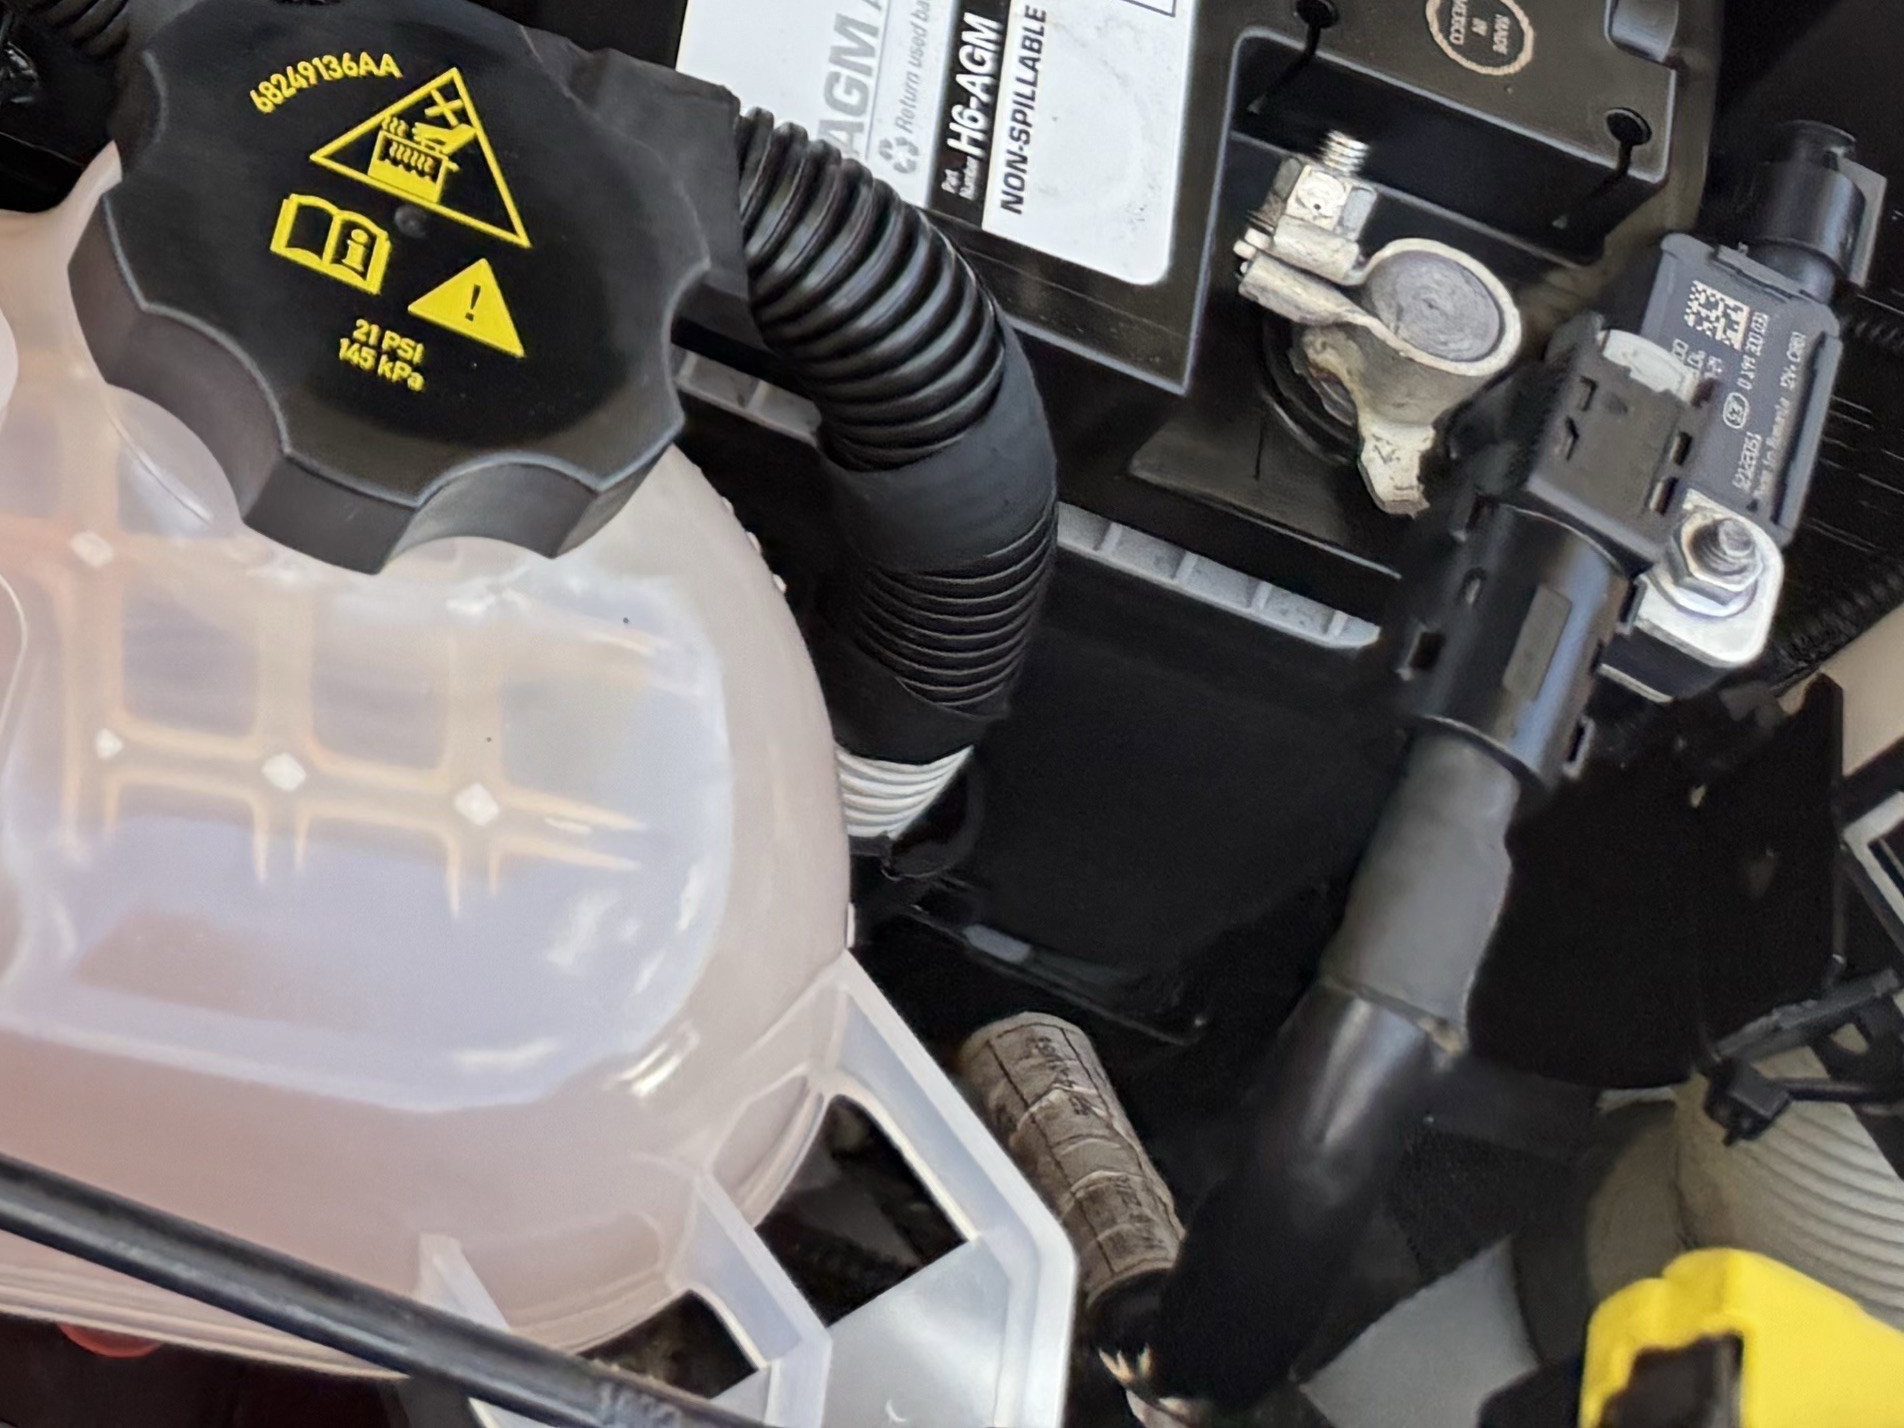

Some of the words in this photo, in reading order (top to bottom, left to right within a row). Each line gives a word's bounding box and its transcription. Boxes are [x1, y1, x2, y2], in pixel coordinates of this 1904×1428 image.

[249, 52, 404, 115] 68249136AA
[814, 13, 879, 157] AGM
[894, 71, 920, 134] Return
[908, 21, 928, 69] used
[947, 12, 1001, 157] H6-AGM
[1001, 5, 1046, 215] NON-SPILLABLE
[338, 338, 376, 369] 145
[377, 354, 425, 391] kPa
[352, 317, 380, 342] 21
[382, 327, 425, 364] PSI
